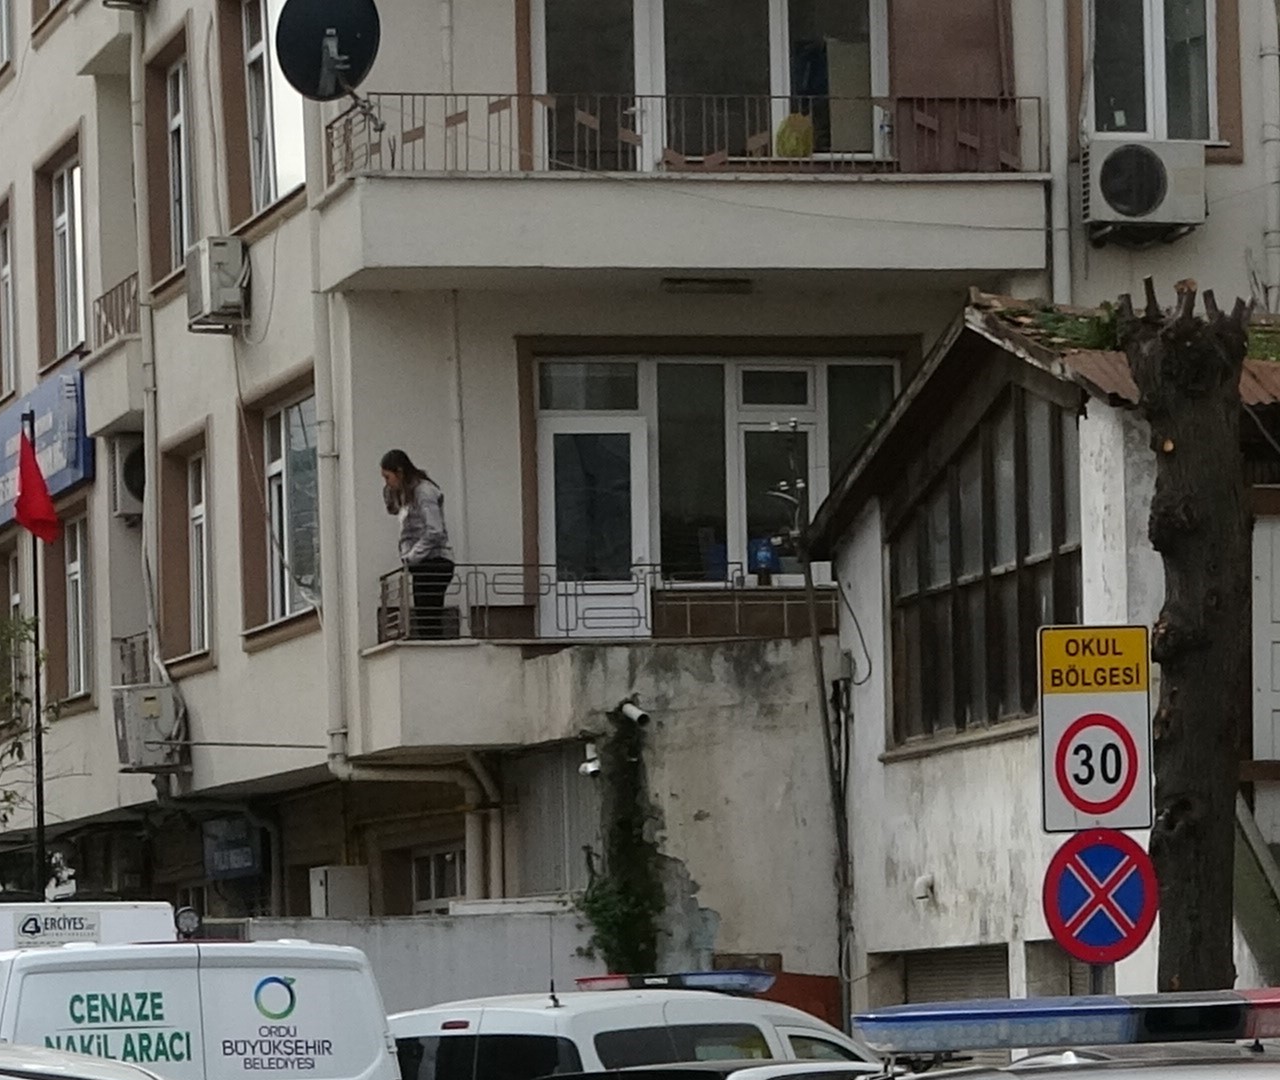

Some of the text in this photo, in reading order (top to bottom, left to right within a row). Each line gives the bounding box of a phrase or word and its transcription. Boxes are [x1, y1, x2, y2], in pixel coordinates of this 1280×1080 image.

[1065, 638, 1124, 657] OKUL
[1051, 663, 1141, 688] BÖLGESİ
[1072, 742, 1122, 786] 30
[70, 991, 165, 1024] CENAZE
[259, 1025, 297, 1038] ORDU
[122, 1032, 192, 1063] ARACI
